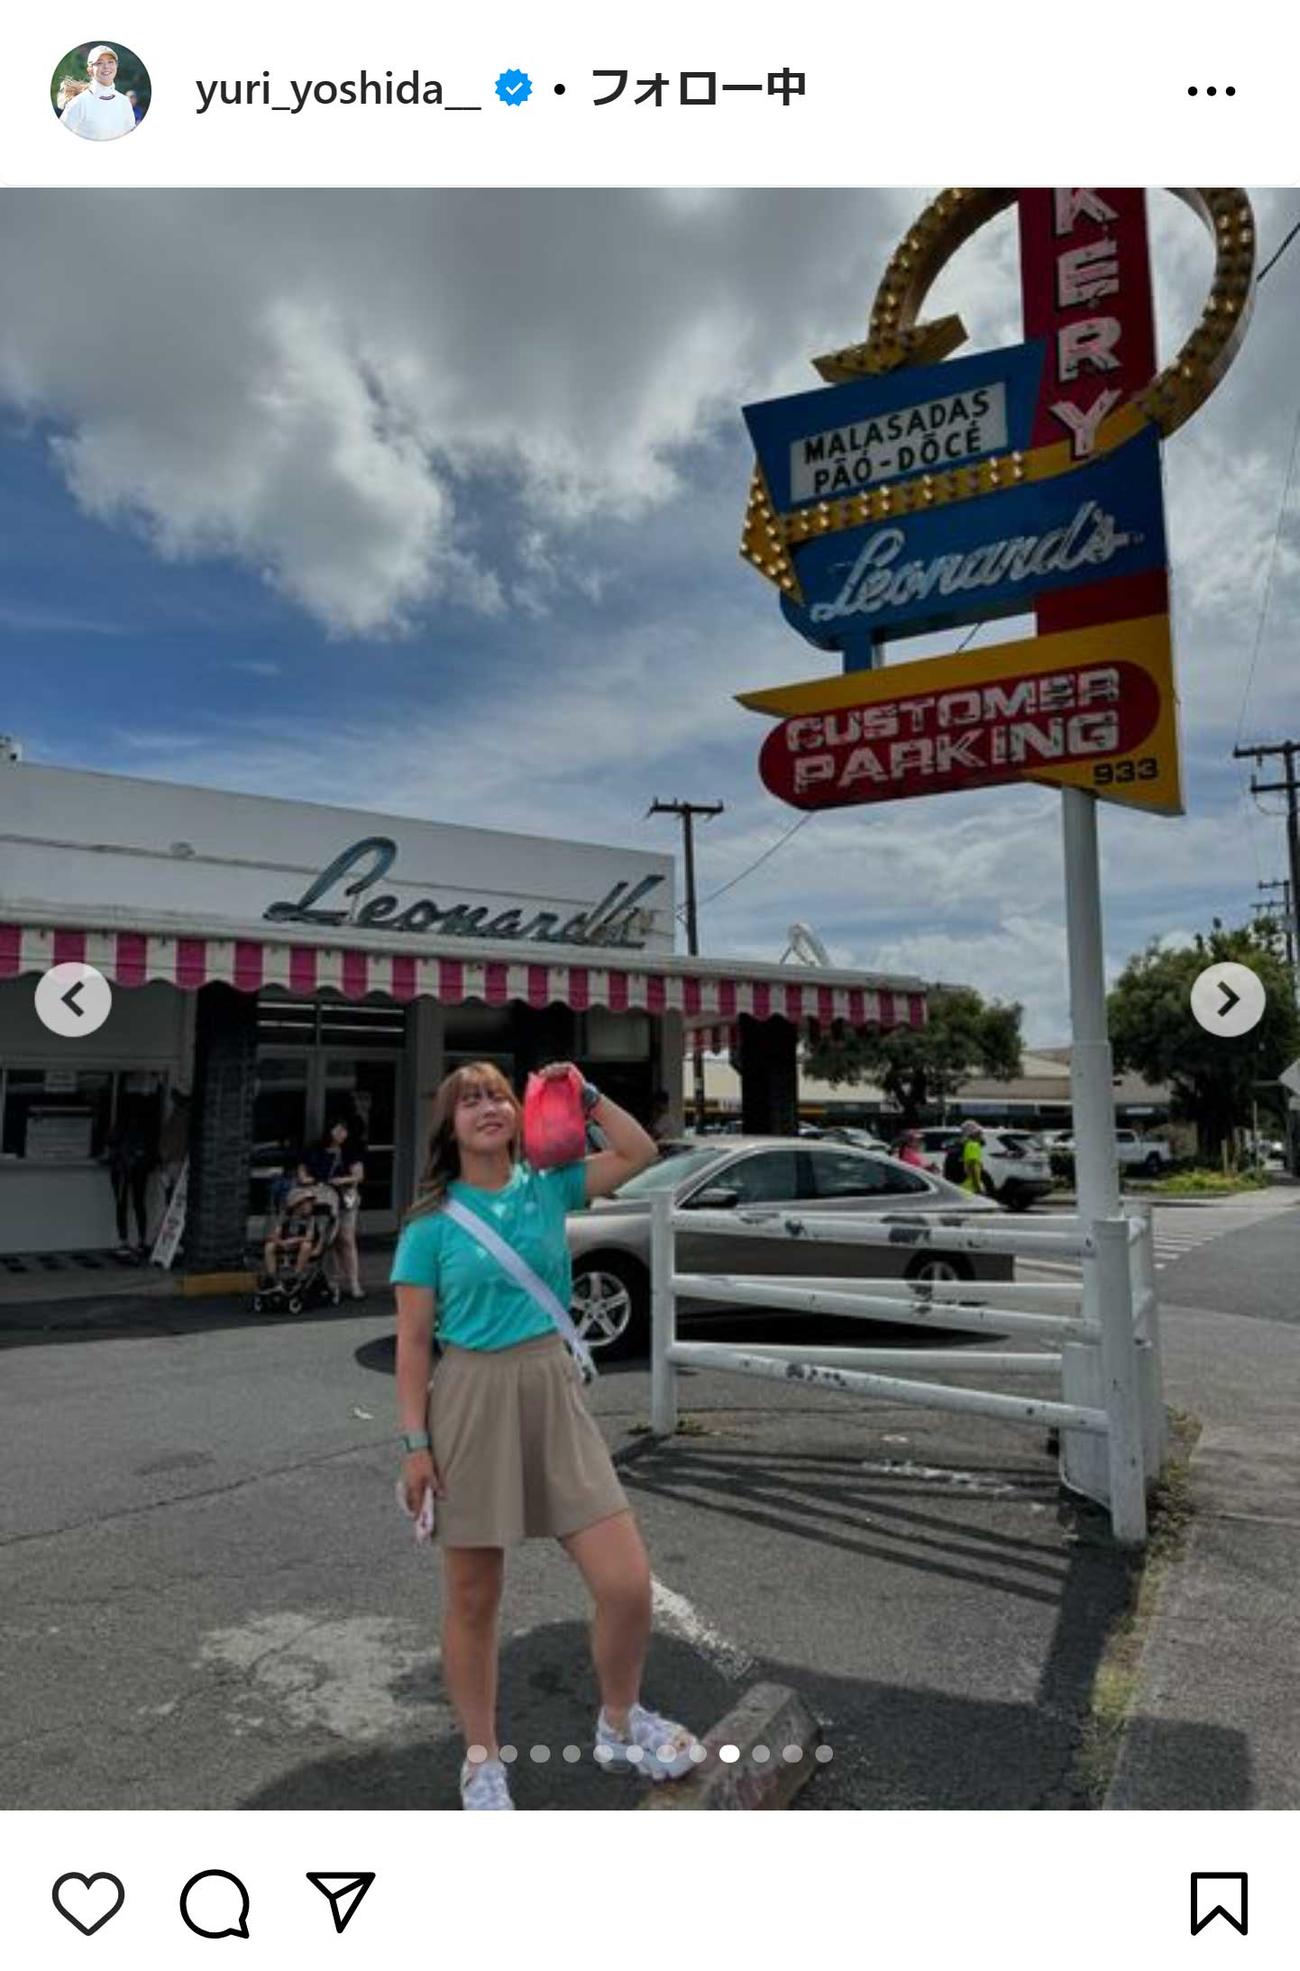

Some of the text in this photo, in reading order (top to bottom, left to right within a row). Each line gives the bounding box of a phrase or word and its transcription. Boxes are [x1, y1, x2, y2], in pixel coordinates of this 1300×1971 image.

[1051, 188, 1122, 459] KERY
[804, 390, 990, 465] MALASADAS
[810, 499, 1131, 622] Leonard's
[785, 668, 1121, 753] CUSTOMER
[793, 709, 1121, 794] PARKING
[1092, 757, 1160, 785] 933
